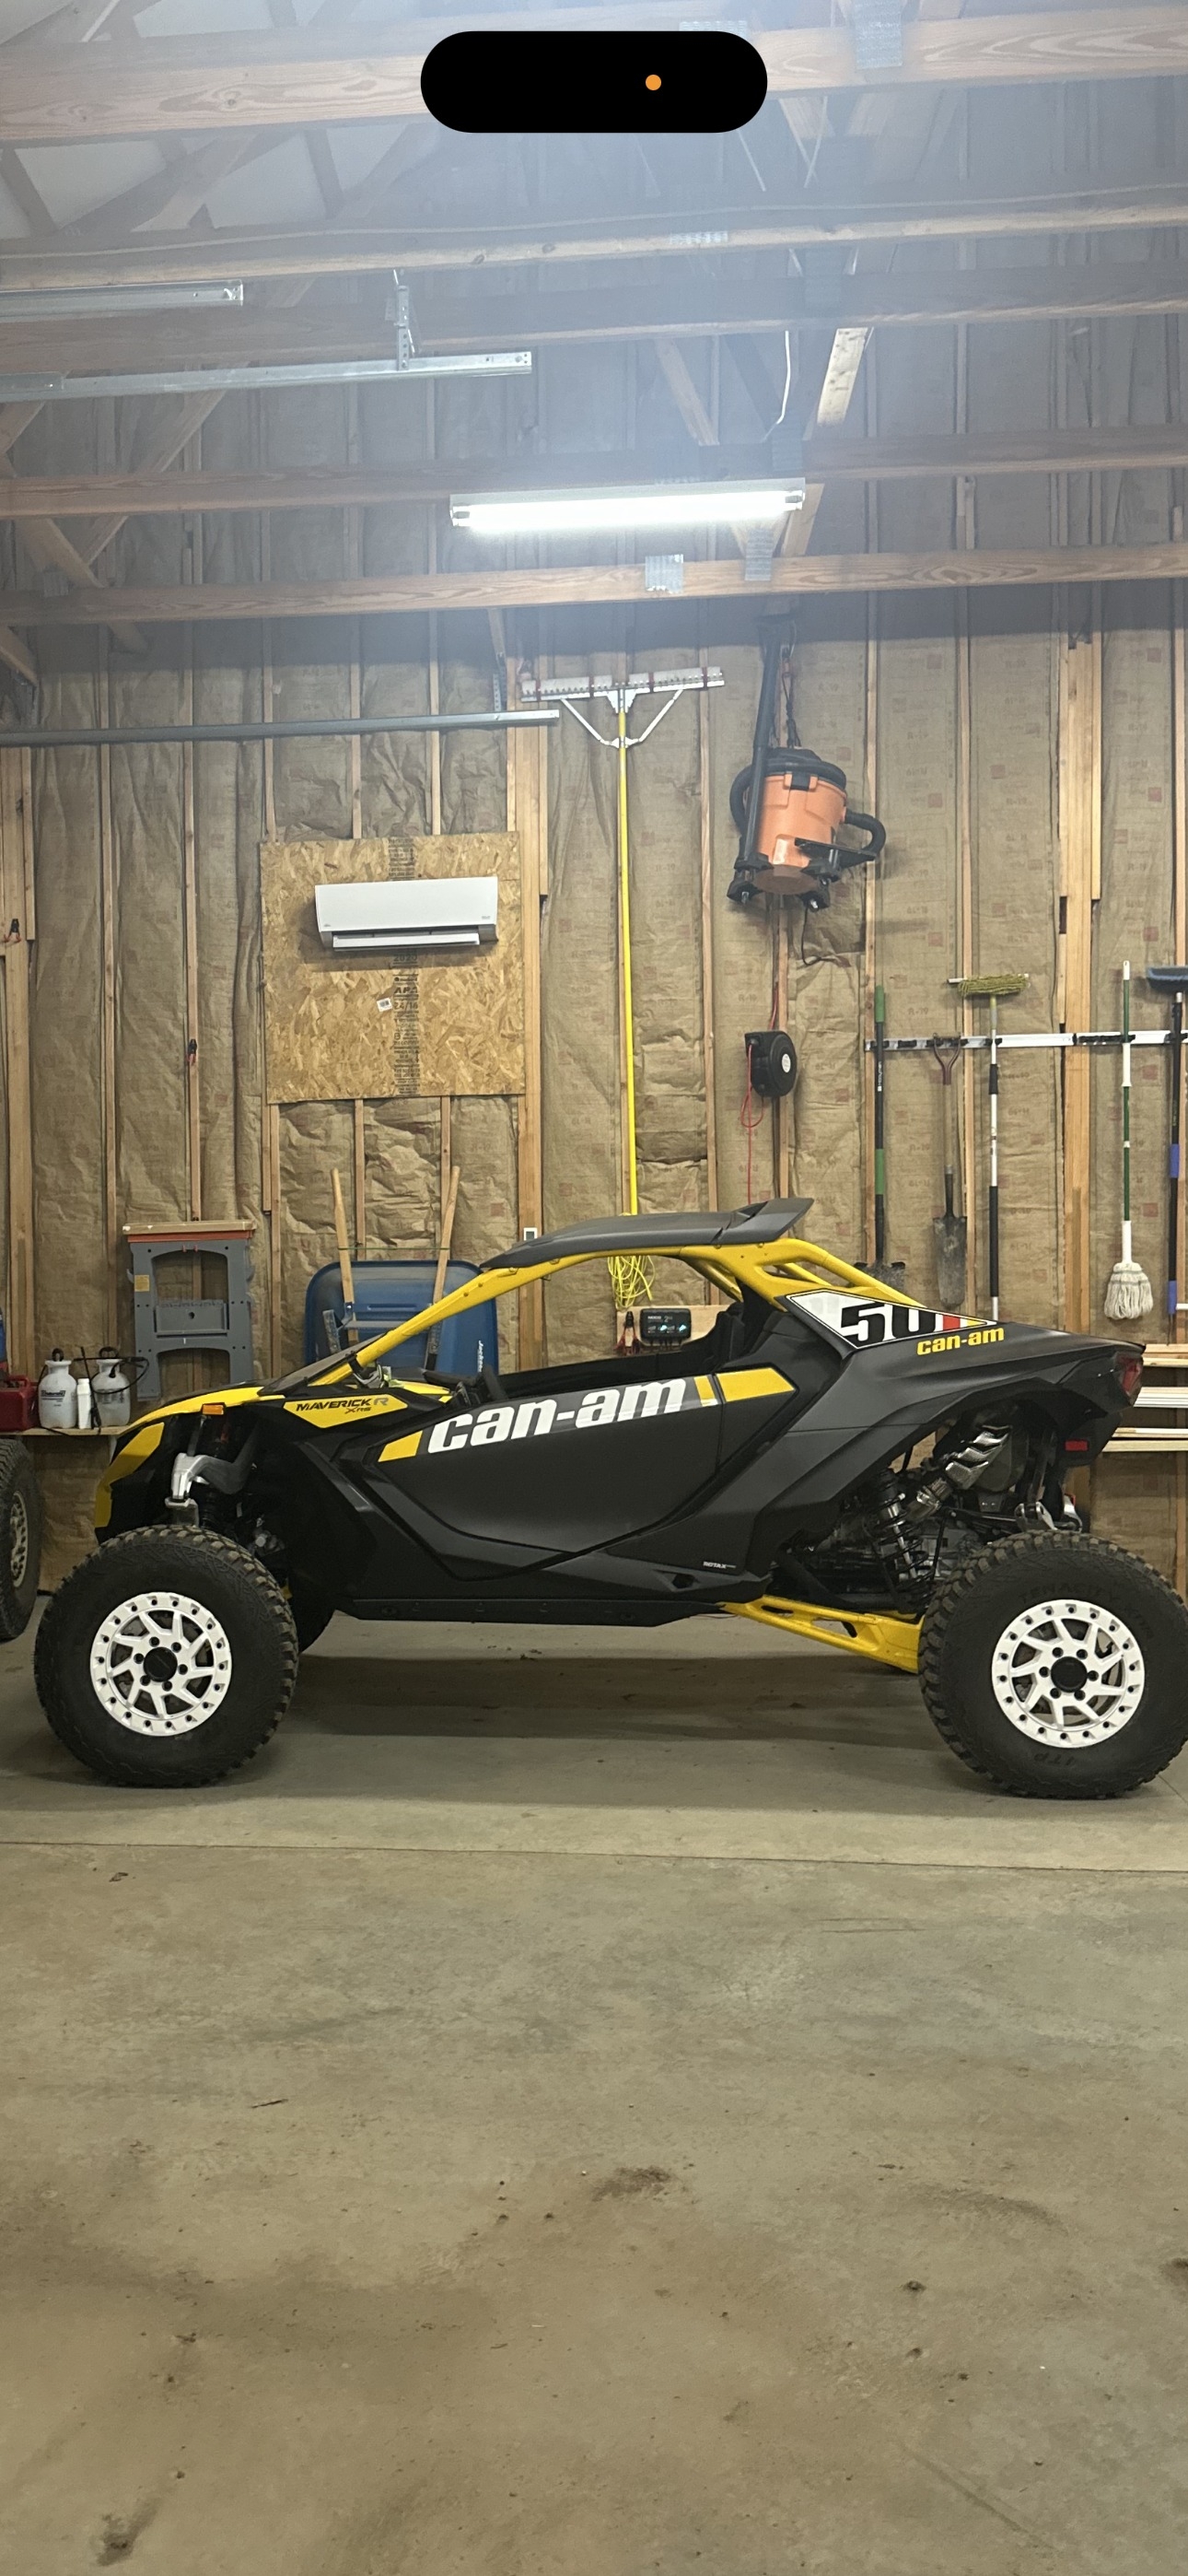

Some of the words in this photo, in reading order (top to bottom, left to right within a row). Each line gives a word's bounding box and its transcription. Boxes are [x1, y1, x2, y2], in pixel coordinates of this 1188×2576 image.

[916, 1327, 1005, 1355] can-am
[296, 1399, 373, 1411] MAVERICK
[427, 1377, 687, 1454] can-am
